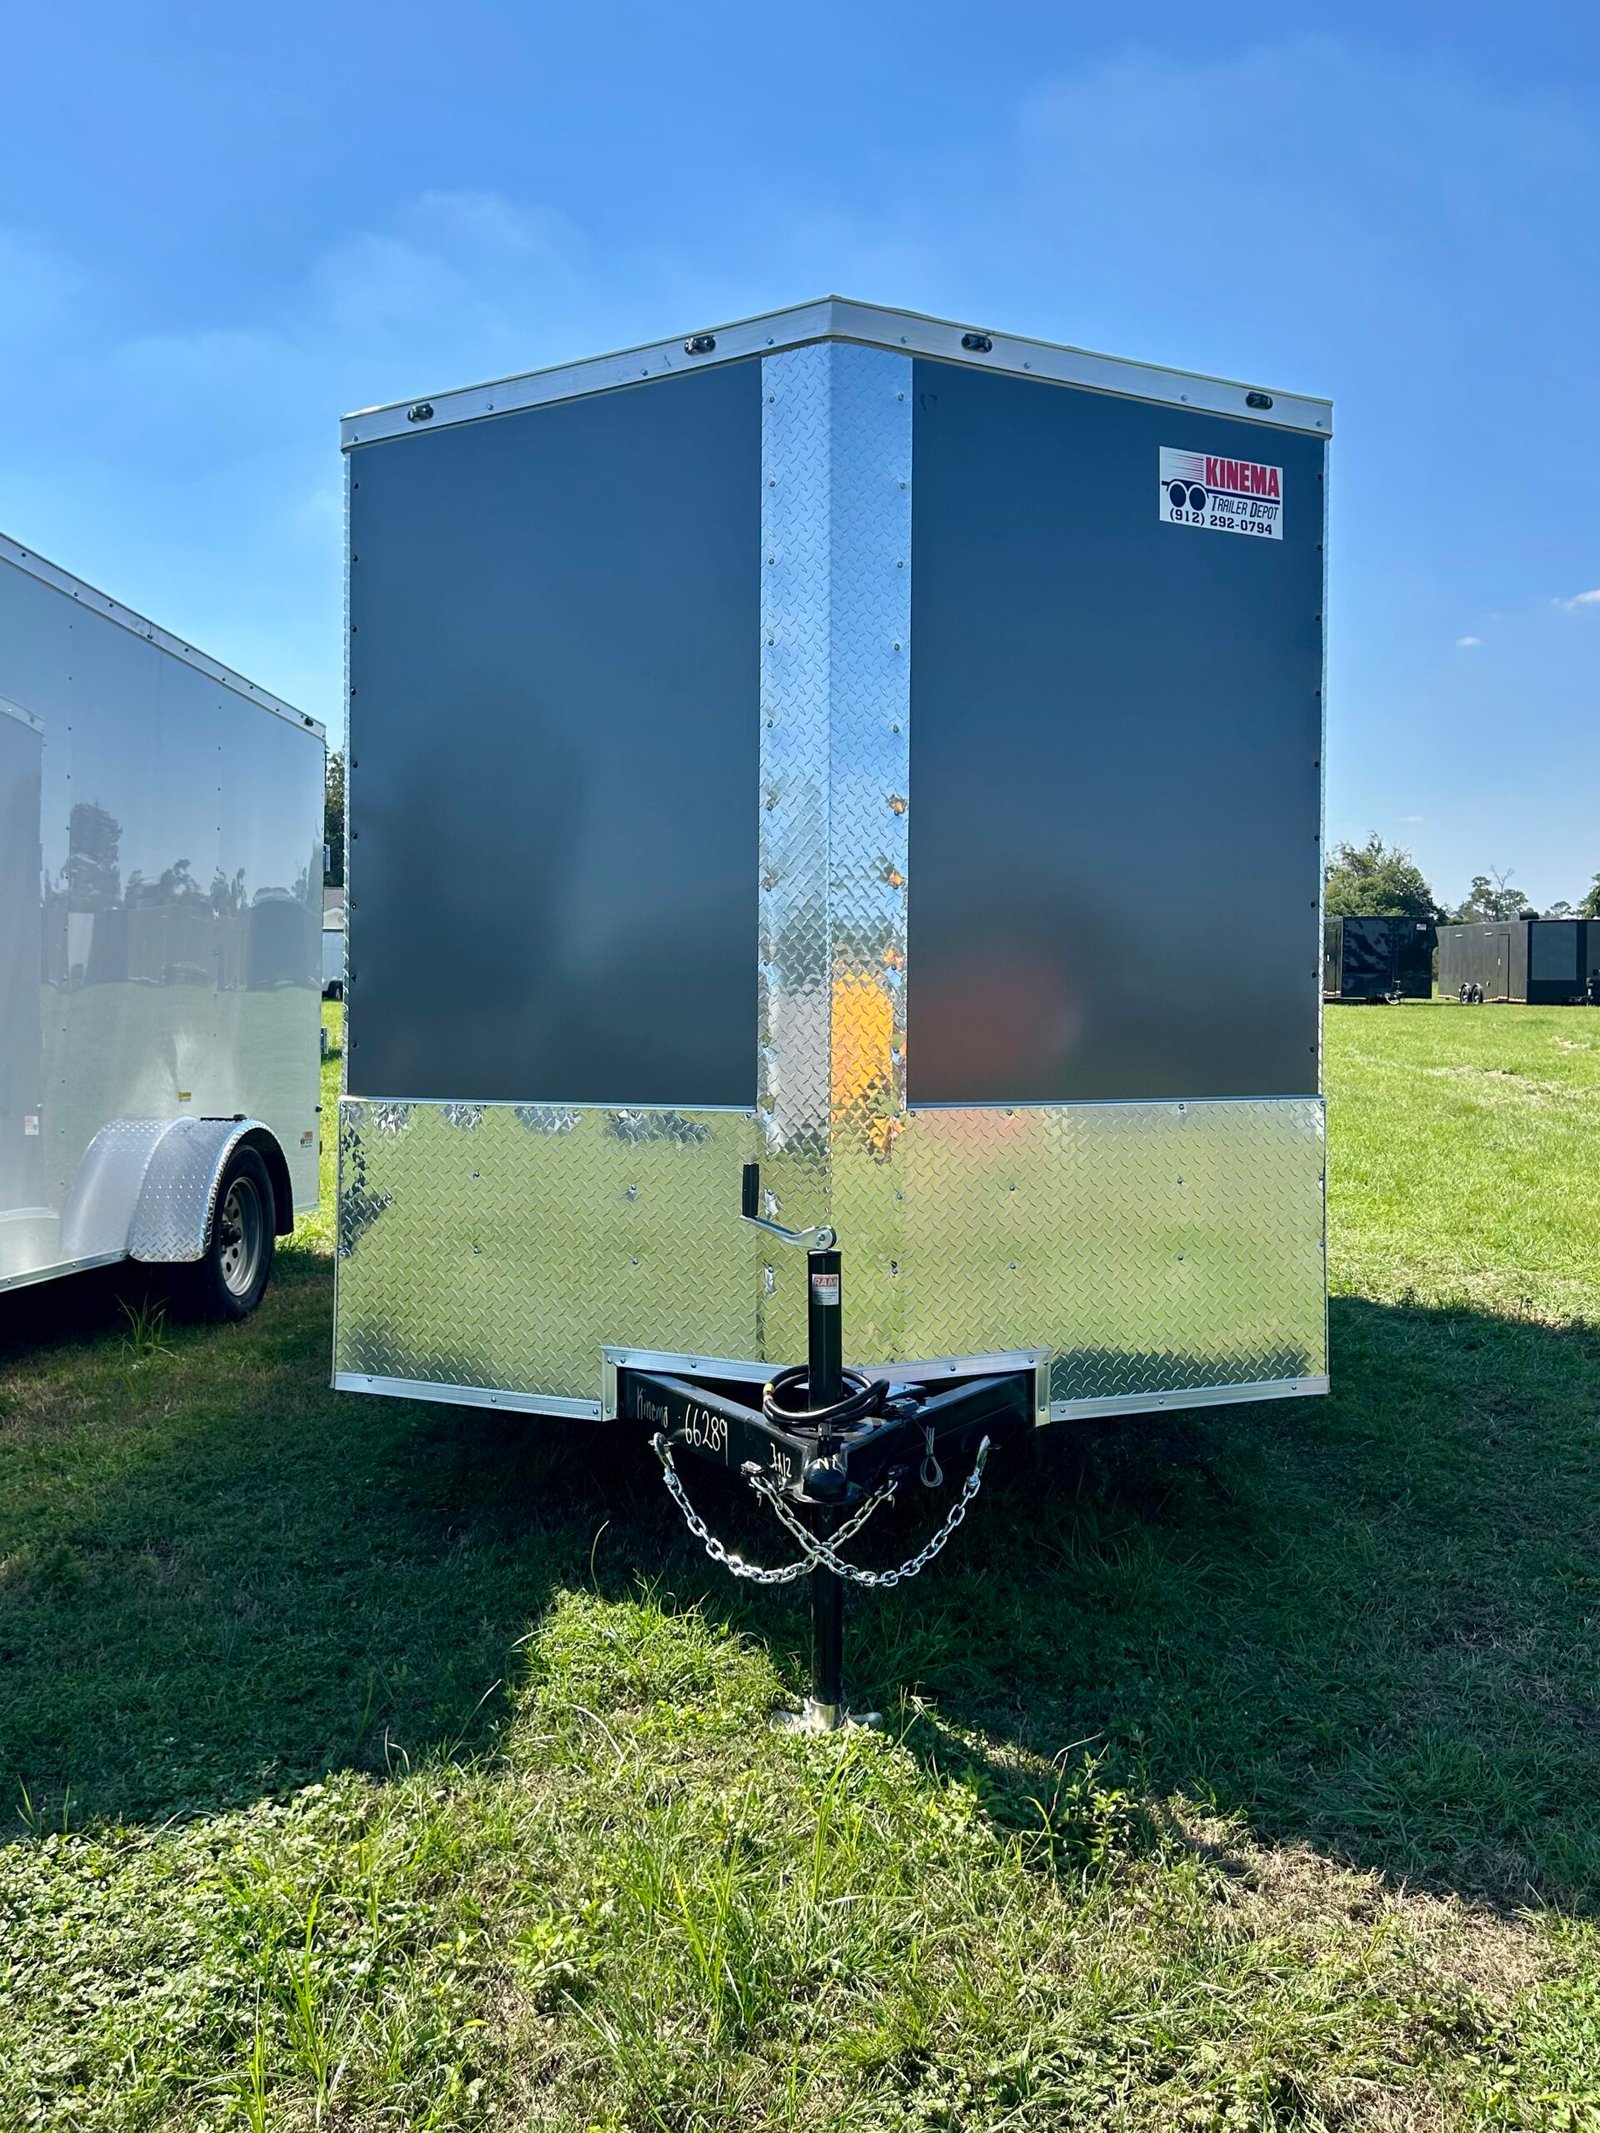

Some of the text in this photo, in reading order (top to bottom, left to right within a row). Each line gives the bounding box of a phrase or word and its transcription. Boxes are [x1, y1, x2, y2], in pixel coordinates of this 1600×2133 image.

[1205, 456, 1280, 498] KINEMA
[1170, 507, 1273, 535] (912) 292-0794
[1211, 495, 1279, 521] TRAILER DEPOT
[684, 1403, 729, 1467] 66289
